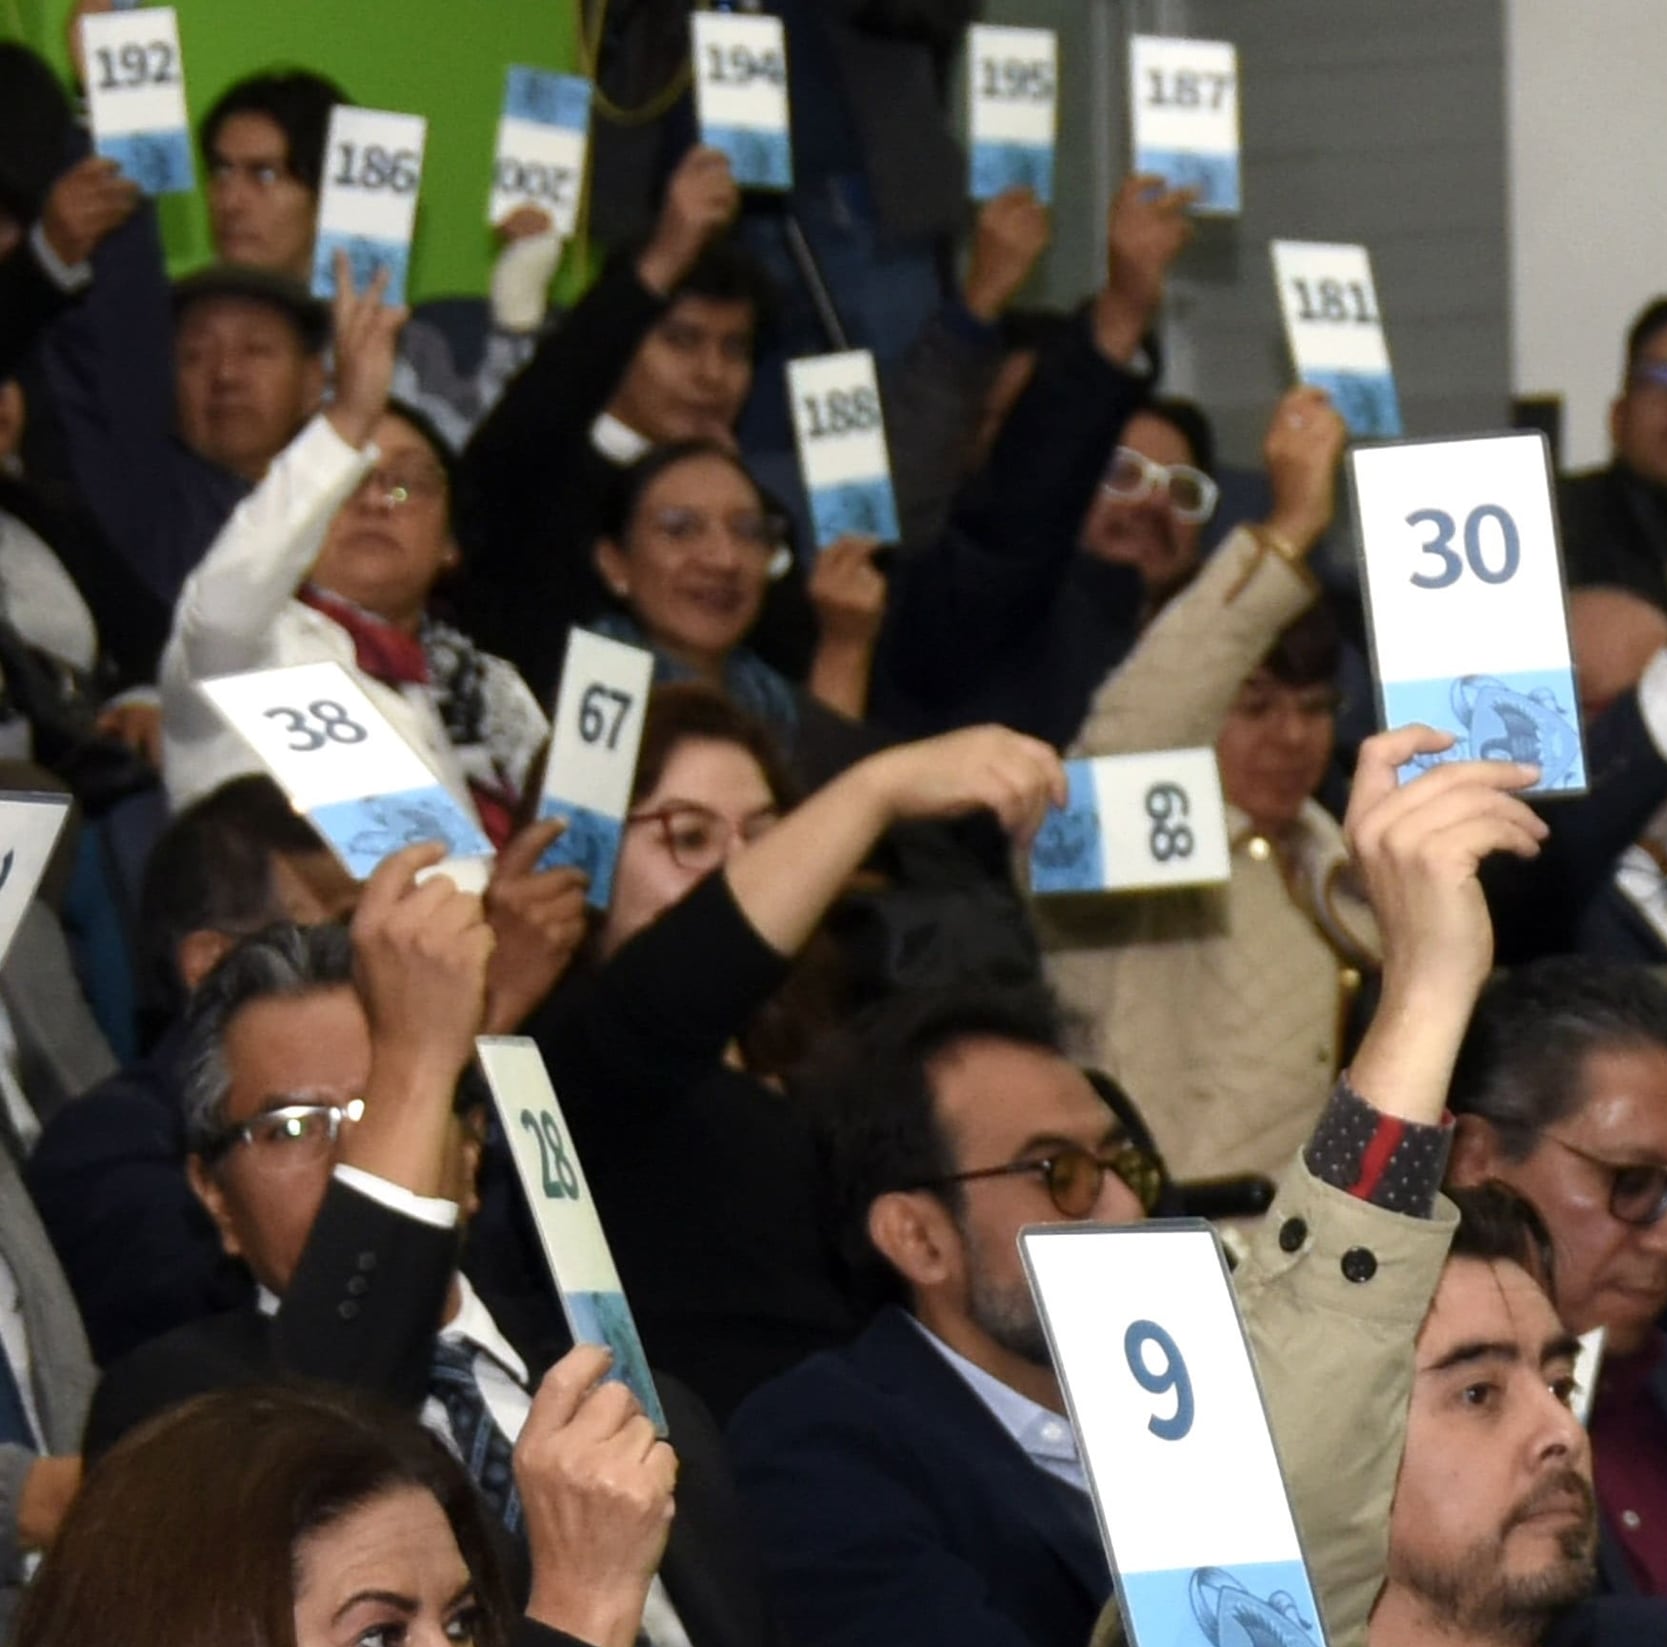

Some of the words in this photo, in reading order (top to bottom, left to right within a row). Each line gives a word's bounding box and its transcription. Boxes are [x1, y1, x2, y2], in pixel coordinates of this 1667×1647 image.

[97, 42, 174, 89] 192
[704, 43, 787, 87] 194
[981, 55, 1055, 101] 195
[1146, 66, 1236, 109] 187
[336, 143, 418, 194] 186
[1292, 278, 1380, 325] 181
[1405, 503, 1521, 589] 30
[261, 699, 368, 752] 38
[577, 684, 633, 752] 67
[1144, 781, 1194, 862] 68
[520, 1108, 580, 1201] 28
[1124, 1319, 1195, 1441] 9
